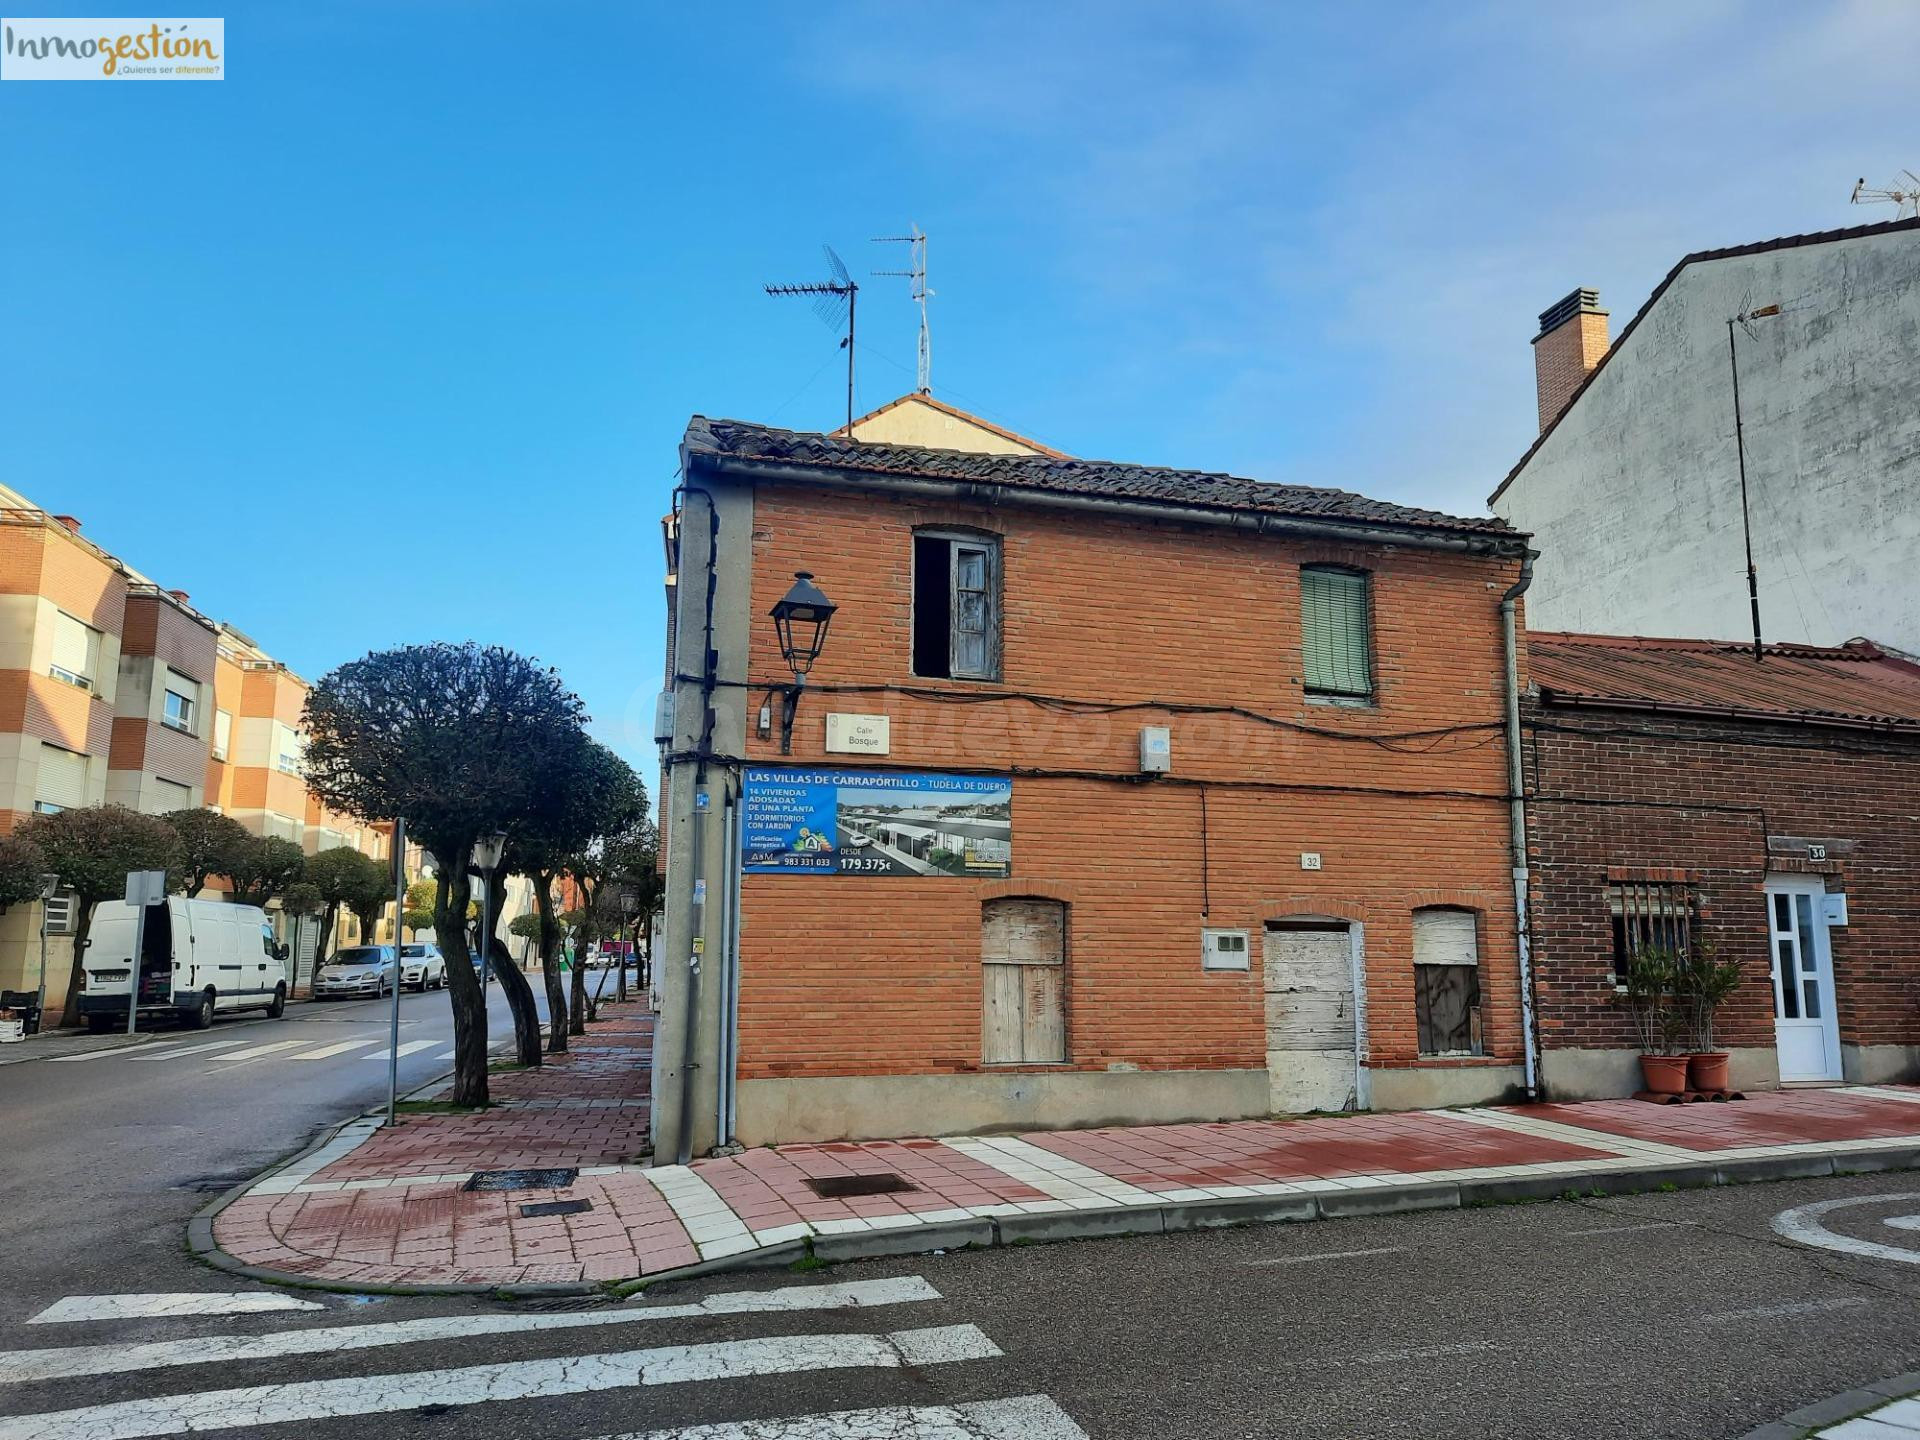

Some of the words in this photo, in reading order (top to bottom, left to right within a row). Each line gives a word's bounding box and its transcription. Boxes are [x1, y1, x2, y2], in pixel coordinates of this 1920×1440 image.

[856, 726, 873, 734] Calle
[848, 736, 879, 746] Bosque
[749, 773, 769, 782] LAS
[774, 774, 811, 784] VILLAS
[815, 775, 829, 784] DE
[929, 780, 961, 789] TUDELA
[964, 782, 975, 790] DE
[978, 782, 1006, 791] DUERO
[754, 814, 805, 822] DORMITORIOS
[1811, 848, 1825, 858] 30
[784, 858, 798, 866] 983
[801, 858, 813, 866] 331
[816, 858, 830, 866] 033
[840, 858, 891, 870] 179.375€
[1307, 857, 1317, 866] 32
